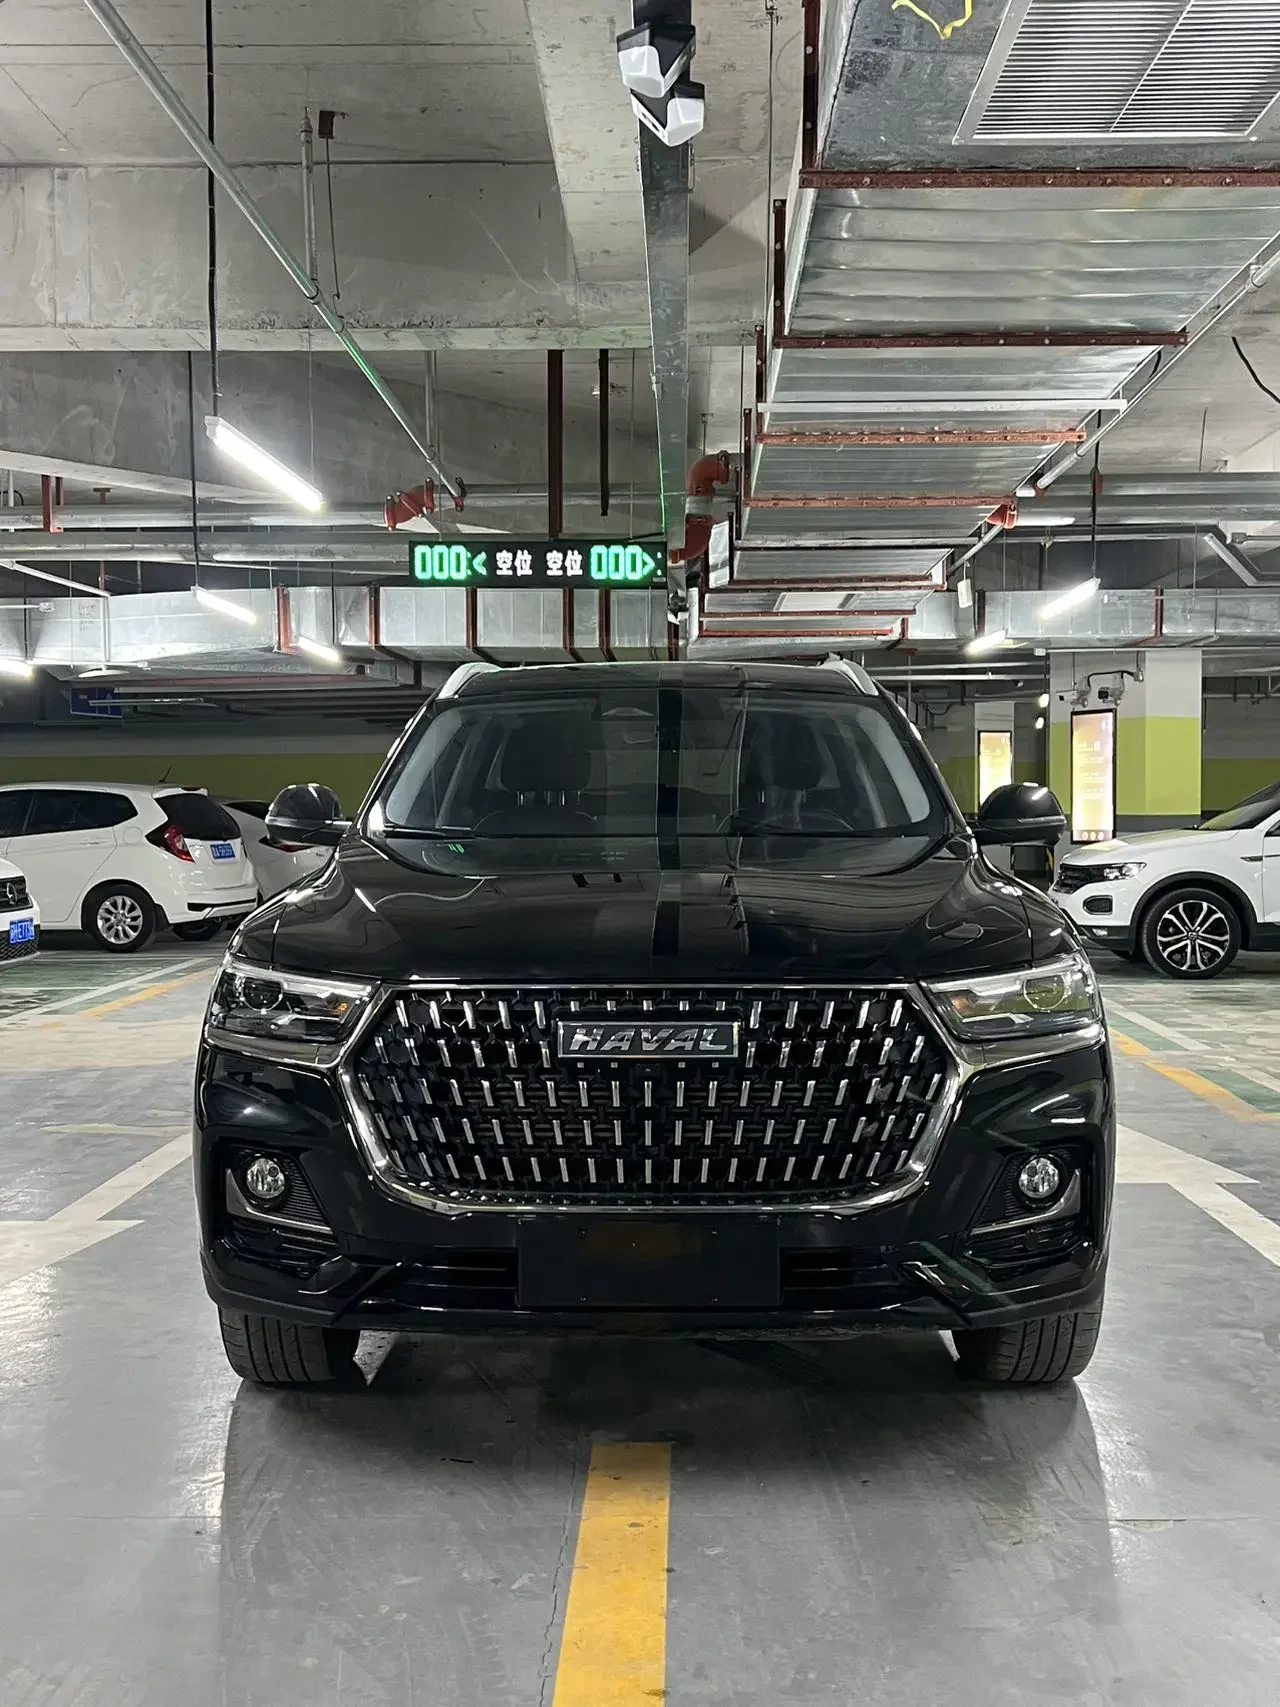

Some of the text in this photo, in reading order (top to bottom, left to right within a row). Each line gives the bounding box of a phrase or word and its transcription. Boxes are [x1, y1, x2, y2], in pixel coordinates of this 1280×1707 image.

[496, 550, 533, 576] 空位
[546, 550, 583, 576] 空位
[569, 1028, 728, 1051] HAVAL
